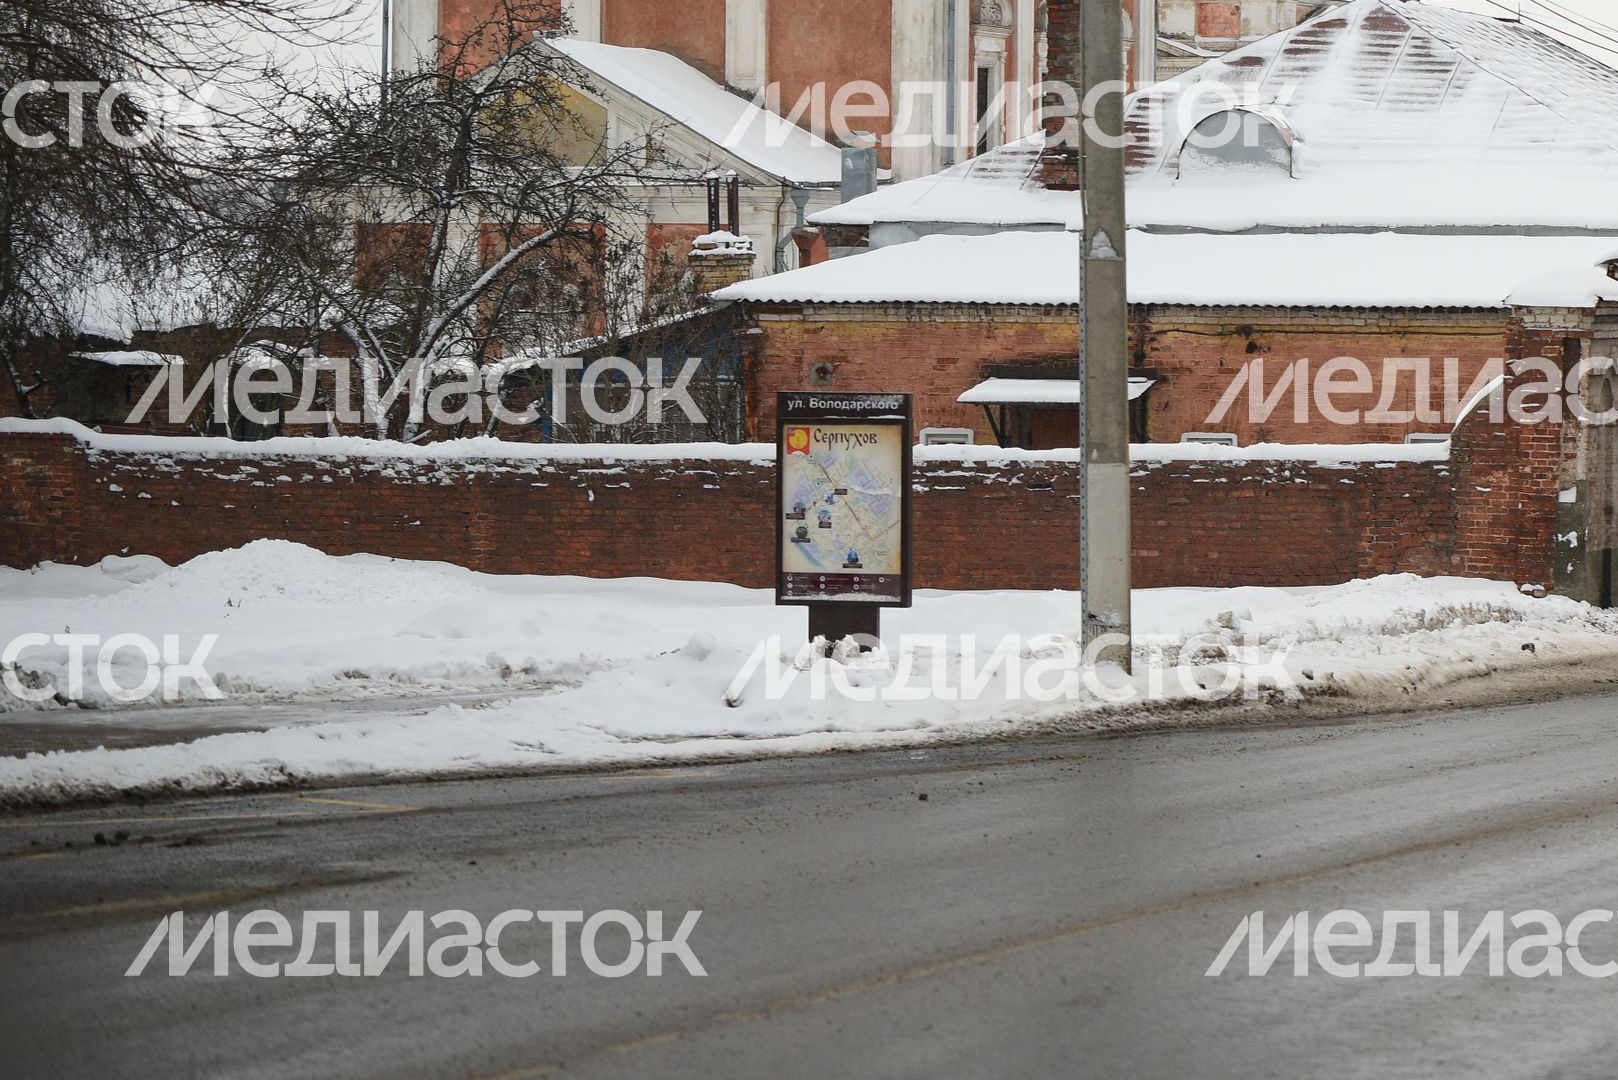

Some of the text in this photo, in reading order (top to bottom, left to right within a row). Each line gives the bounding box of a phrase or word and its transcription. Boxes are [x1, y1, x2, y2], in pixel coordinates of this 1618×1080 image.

[788, 397, 899, 411] ул. Володарского
[813, 428, 878, 451] Серпухов
